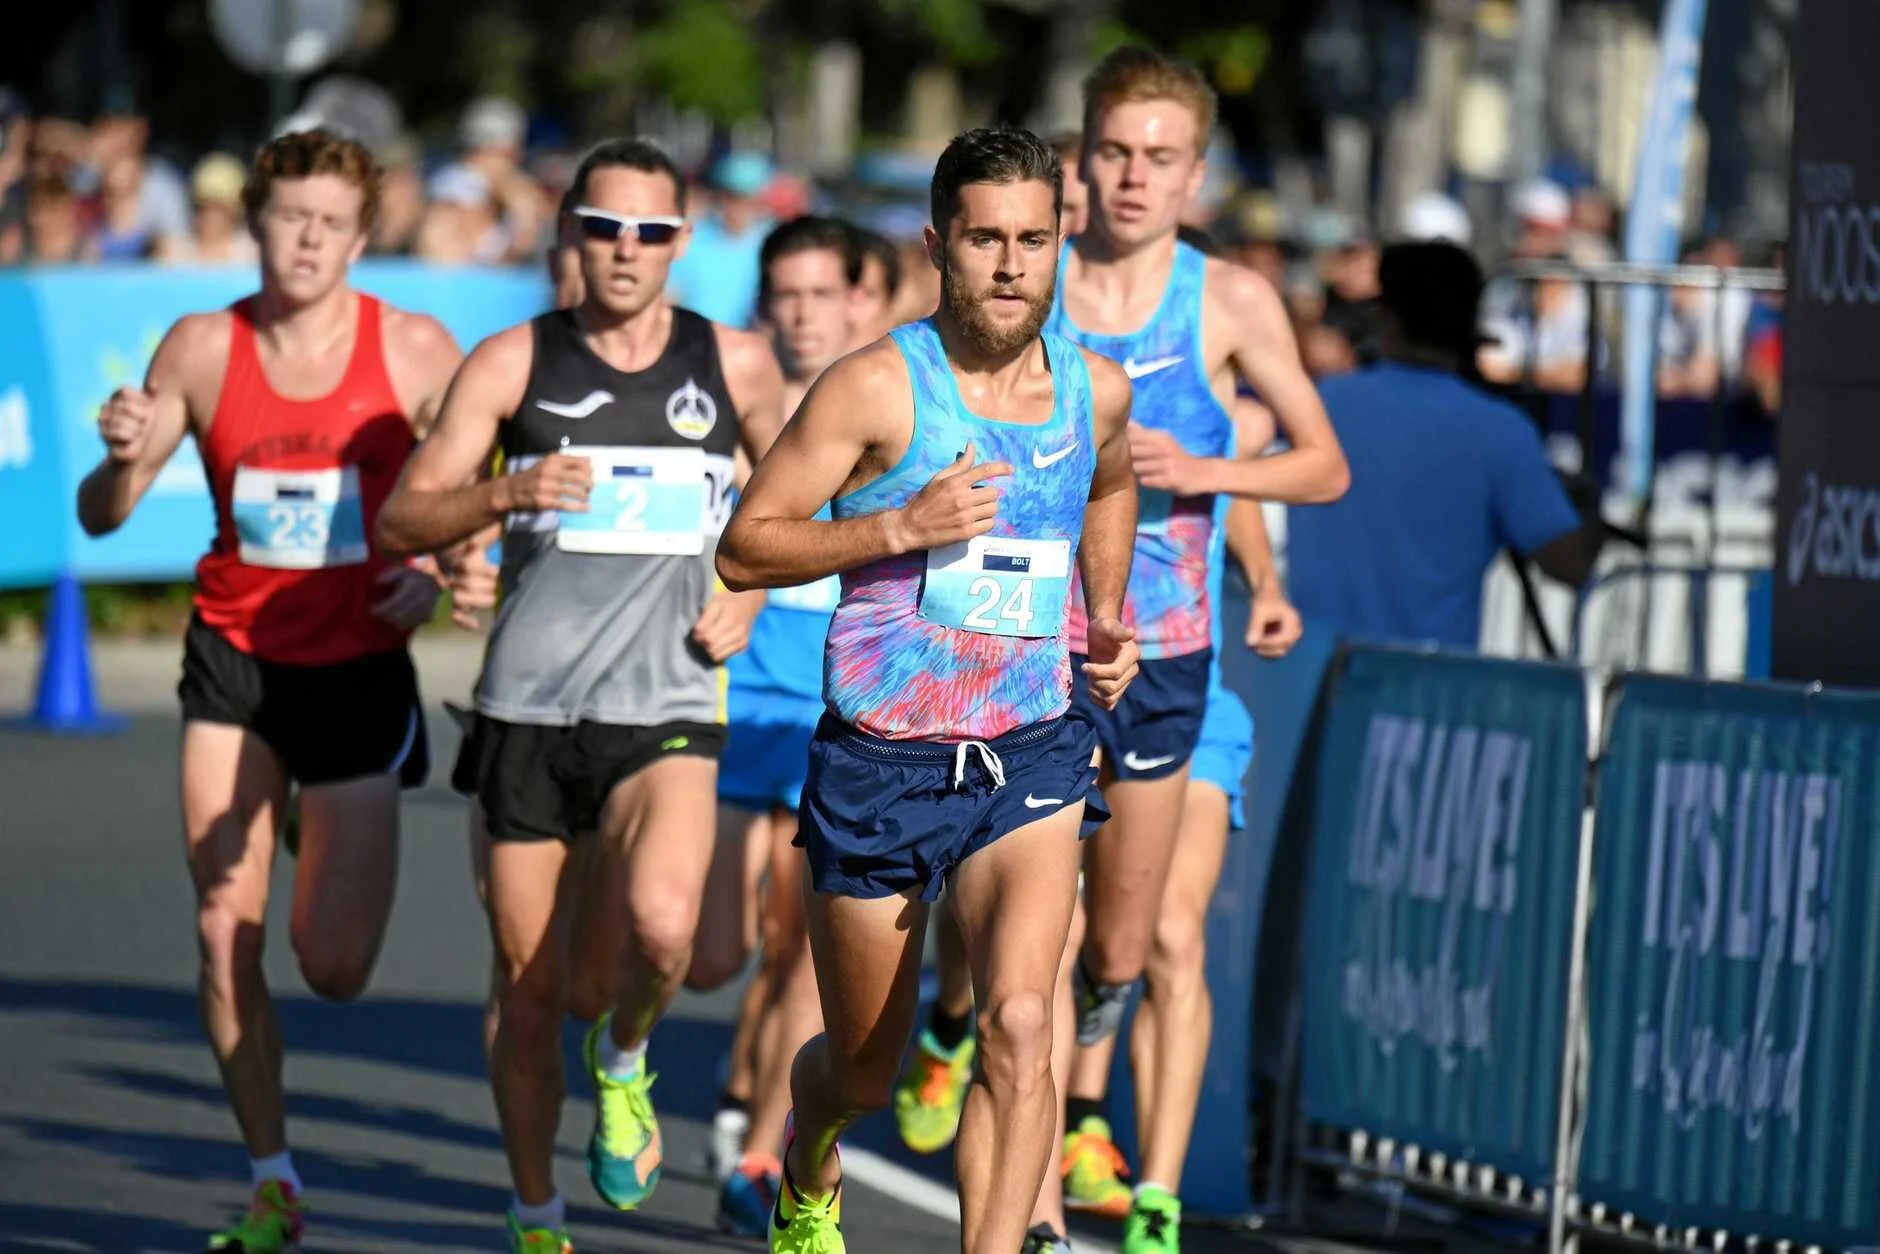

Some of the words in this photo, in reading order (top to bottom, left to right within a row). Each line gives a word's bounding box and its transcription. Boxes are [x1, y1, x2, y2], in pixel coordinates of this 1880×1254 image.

[268, 504, 326, 548] 23
[613, 482, 648, 531] 2
[1011, 557, 1031, 567] BOLT
[962, 577, 1034, 633] 24
